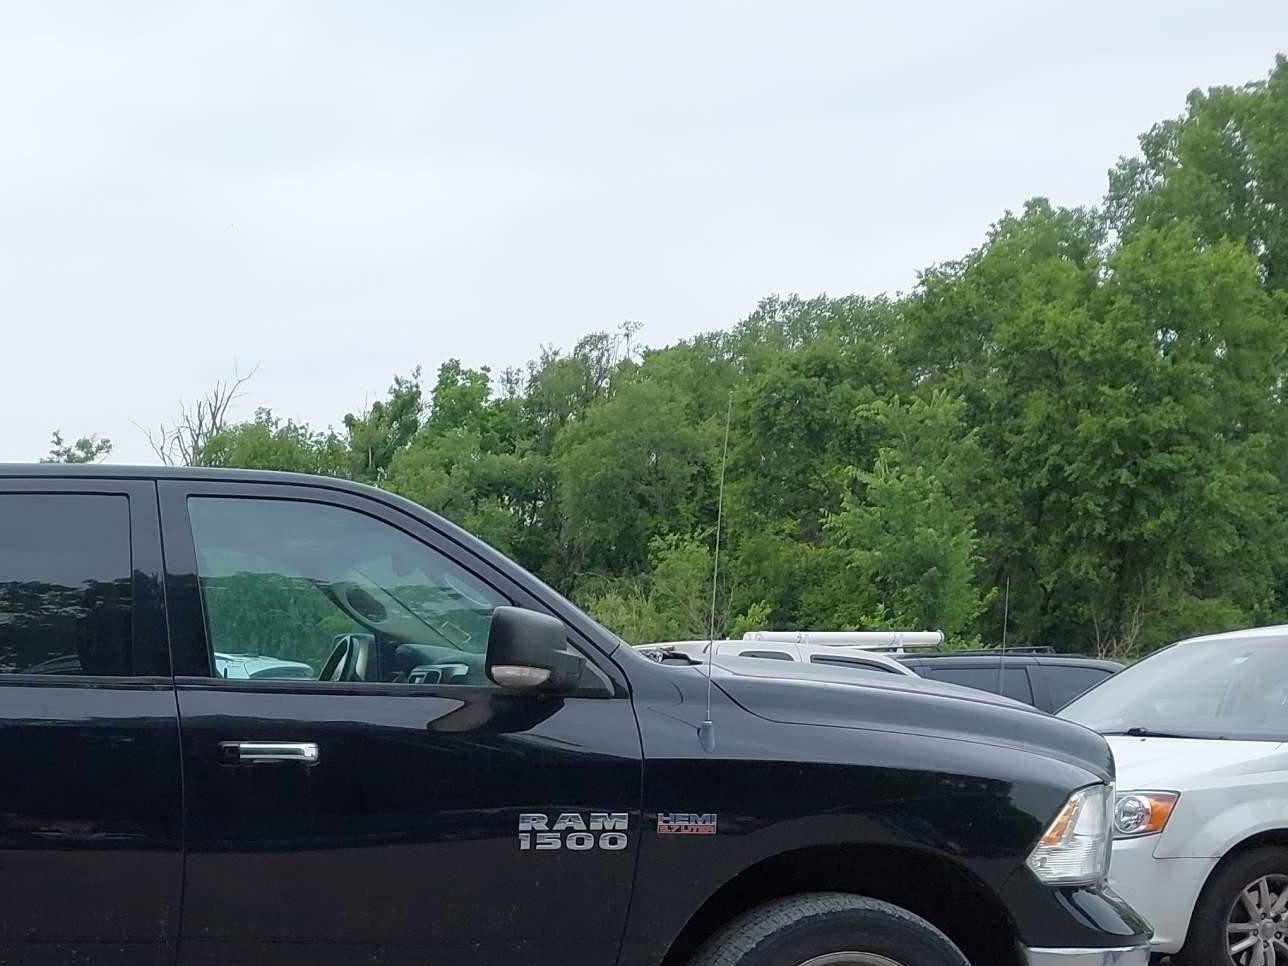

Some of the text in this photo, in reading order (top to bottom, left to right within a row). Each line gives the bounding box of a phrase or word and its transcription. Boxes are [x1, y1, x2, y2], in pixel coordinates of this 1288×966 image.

[518, 813, 628, 830] RAM
[658, 813, 717, 825] HEMI
[518, 833, 628, 850] 1500
